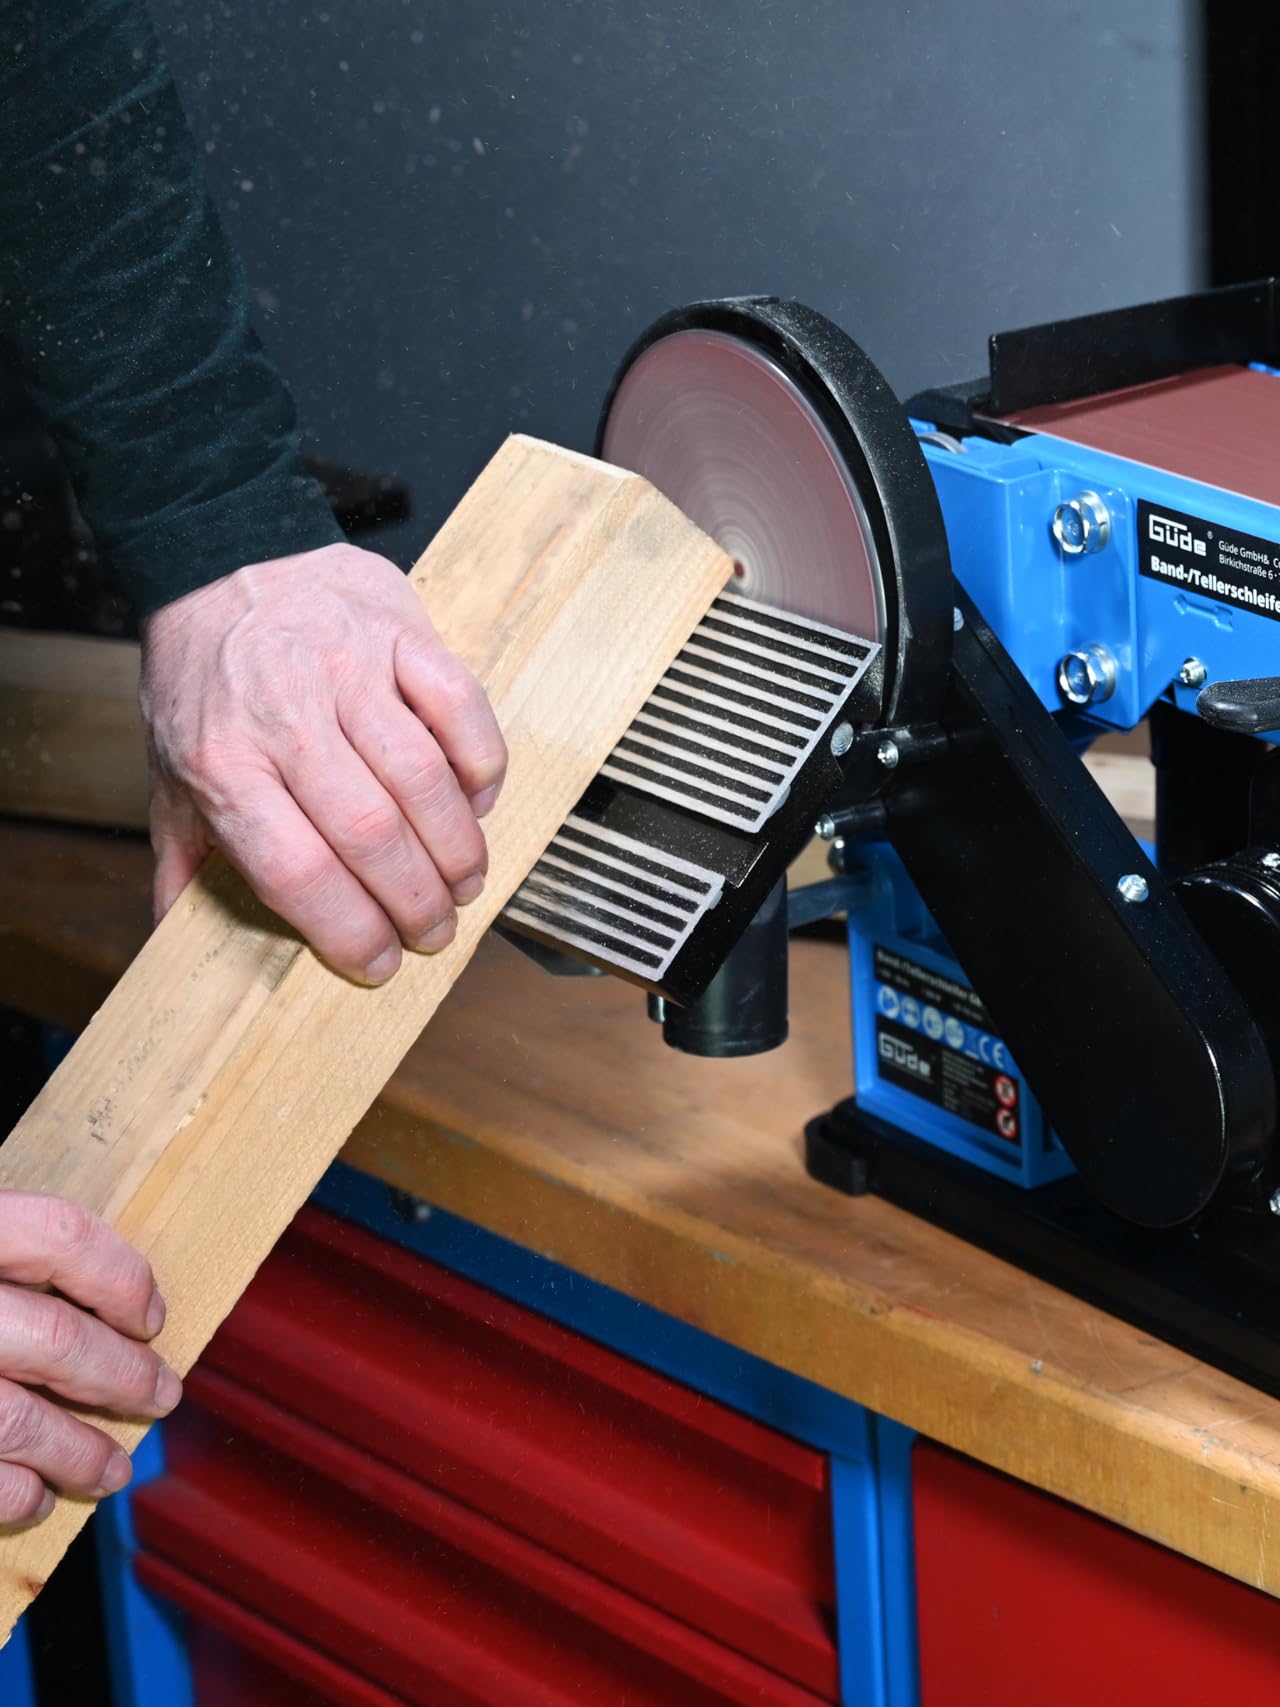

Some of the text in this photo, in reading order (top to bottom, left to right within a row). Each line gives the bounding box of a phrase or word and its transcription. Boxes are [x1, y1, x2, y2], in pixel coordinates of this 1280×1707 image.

[1149, 514, 1207, 556] Güde
[1218, 540, 1239, 555] Güde
[1219, 554, 1267, 578] Birkichstraße
